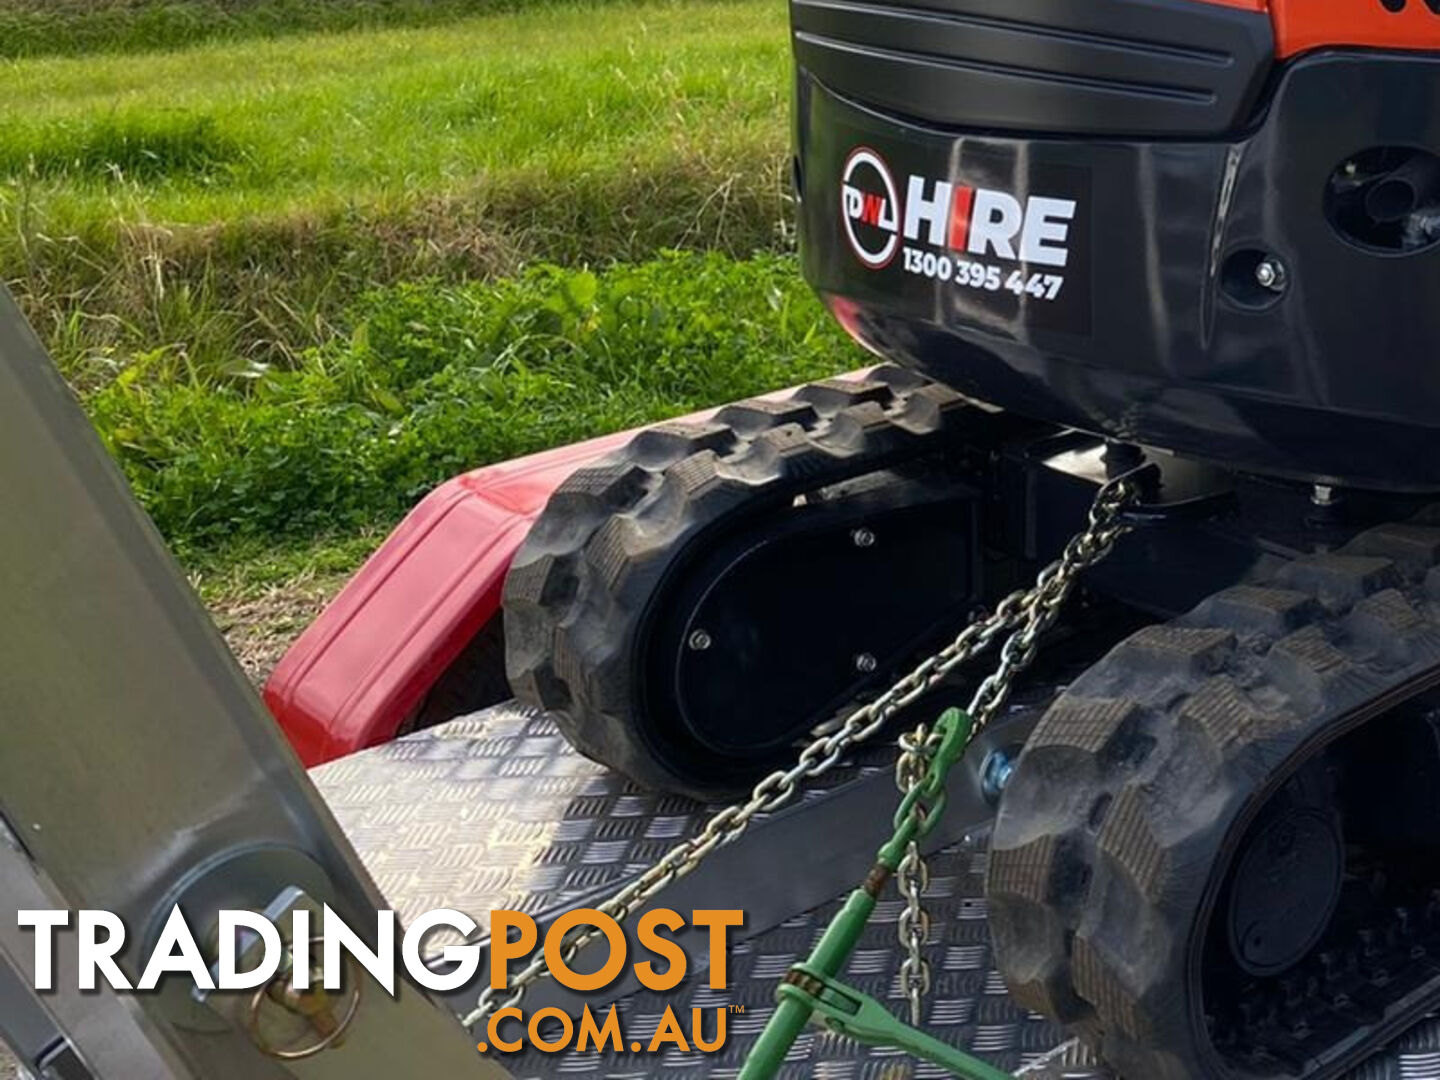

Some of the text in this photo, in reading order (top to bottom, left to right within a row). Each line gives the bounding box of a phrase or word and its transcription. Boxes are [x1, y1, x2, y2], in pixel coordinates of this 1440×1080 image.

[904, 174, 1076, 267] HIRE
[903, 247, 1064, 300] 1300 395 447
